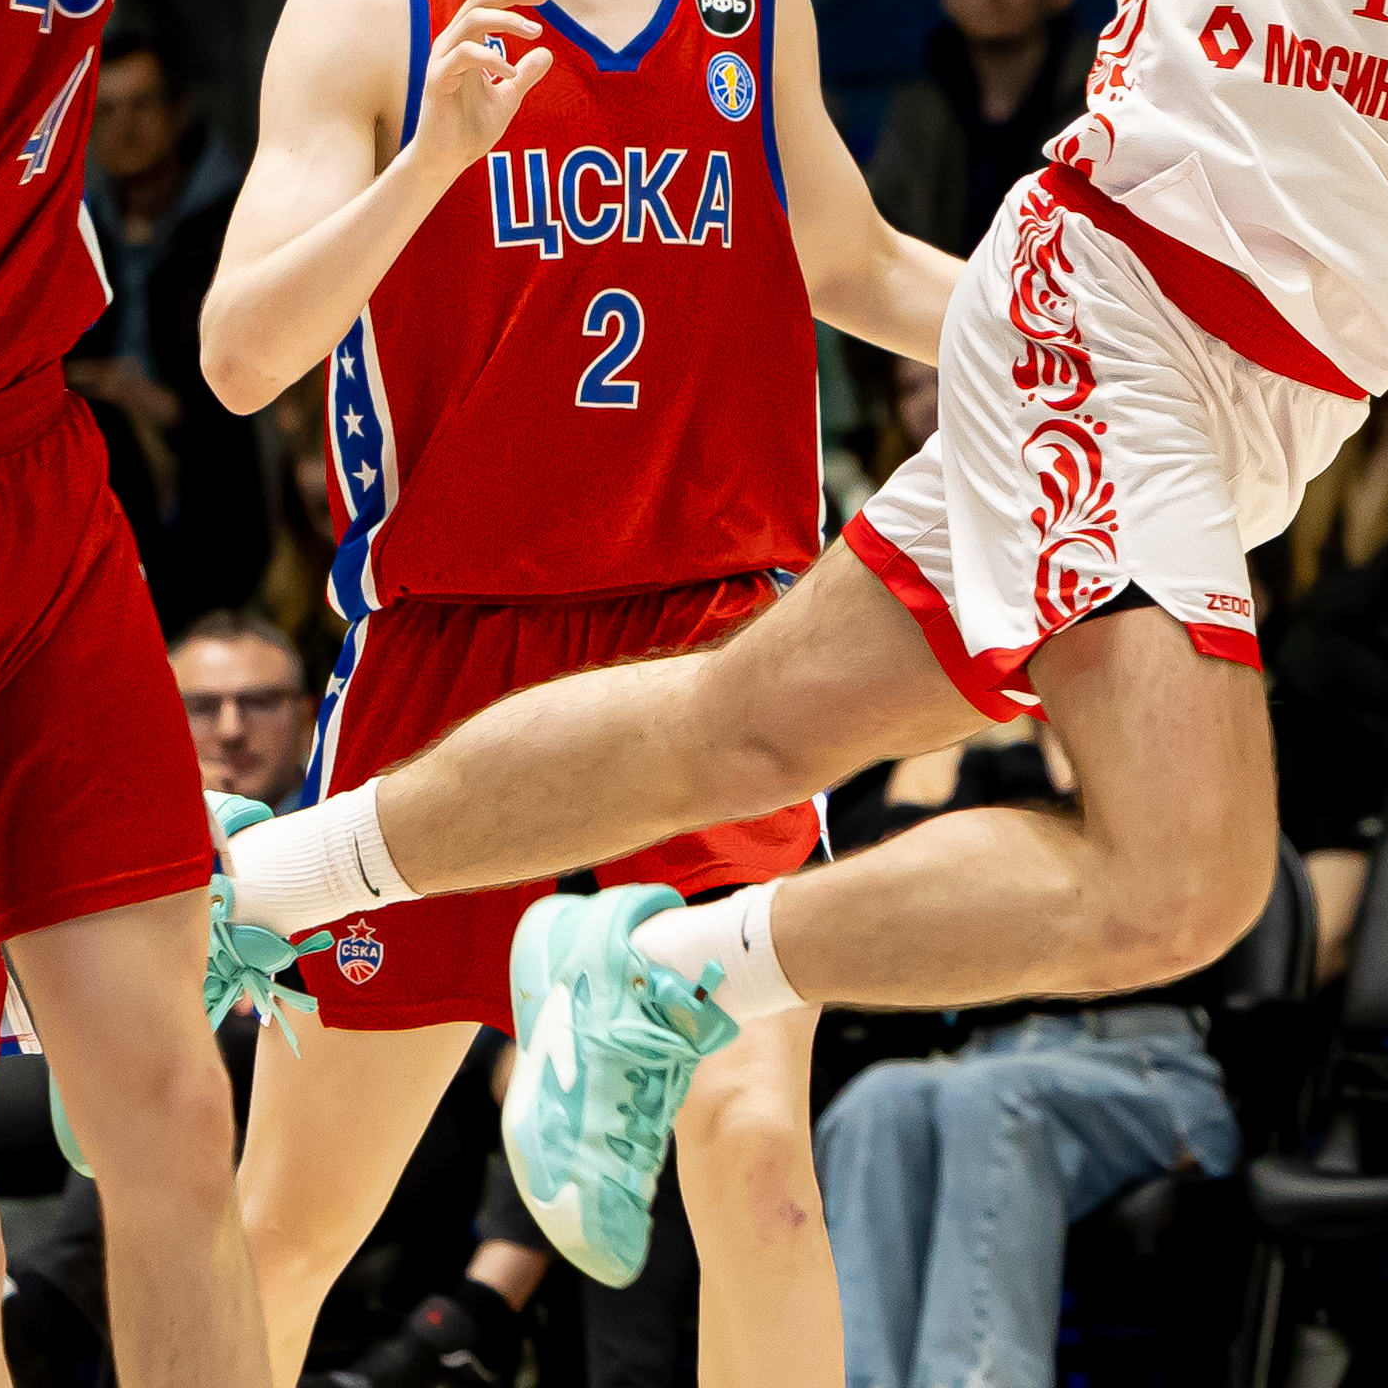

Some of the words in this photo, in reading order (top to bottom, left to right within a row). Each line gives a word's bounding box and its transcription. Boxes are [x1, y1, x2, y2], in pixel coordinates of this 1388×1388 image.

[487, 146, 733, 260] ЦСКА
[574, 288, 645, 410] 2
[341, 943, 379, 959] CSKA
